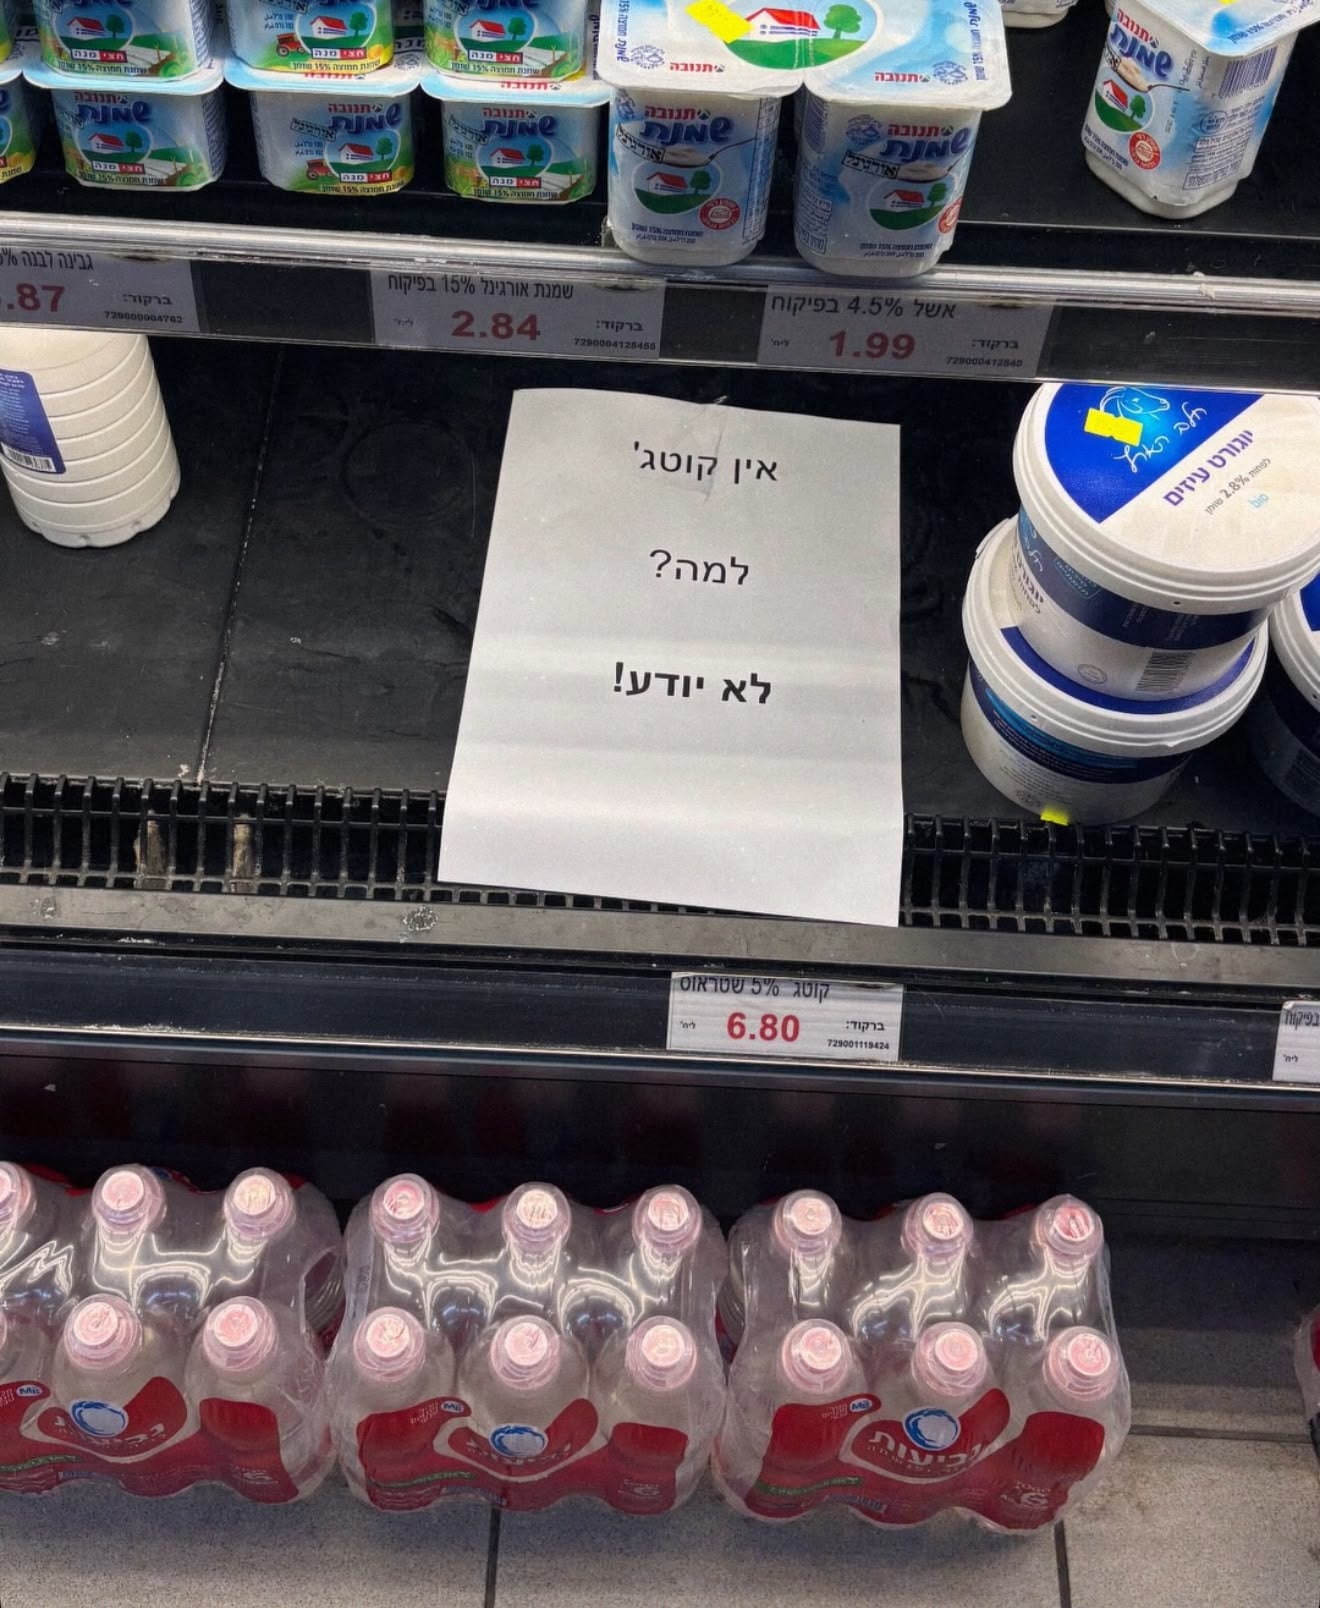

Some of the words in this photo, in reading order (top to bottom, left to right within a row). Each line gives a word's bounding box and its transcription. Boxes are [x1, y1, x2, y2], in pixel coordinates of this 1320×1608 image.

[1116, 8, 1150, 43] תנובה
[1109, 23, 1173, 81] שמנת
[670, 62, 713, 73] תנובה
[875, 71, 919, 83] תנובה
[77, 101, 151, 124] שמנת
[328, 102, 371, 114] תנובה
[328, 102, 402, 134] שמנת
[482, 107, 525, 119] תנובה
[644, 105, 696, 120] תנובה
[480, 115, 557, 138] שמנת
[639, 117, 733, 146] שמנת
[888, 124, 940, 137] תנובה
[879, 127, 971, 163] שמנת
[22, 250, 53, 270] לבנה
[58, 252, 94, 271] גבינה
[387, 274, 437, 296] בפיקוח
[441, 274, 476, 295] 15%
[480, 276, 529, 298] אורגינל
[534, 282, 575, 300] שמנת
[0, 282, 66, 313] .87
[122, 293, 174, 306] ברקוד:
[771, 295, 840, 317] בפיקוח
[847, 296, 904, 317] 4.5%
[914, 298, 957, 319] אשל
[451, 310, 541, 341] 2.84
[595, 319, 644, 333] ברקוד:
[829, 329, 915, 360] 1.99
[971, 339, 1019, 351] ברקוד:
[1206, 429, 1254, 470] יוגורט
[633, 440, 719, 482] קוטג'
[733, 457, 779, 485] אין
[1162, 466, 1211, 507] עיזים
[1219, 474, 1250, 499] 2.8%
[649, 548, 750, 586] למה?
[613, 661, 705, 698] יודע!
[720, 672, 772, 705] לא
[680, 976, 745, 995] שטראוס
[751, 977, 780, 997] 5%
[792, 982, 831, 1005] קוטג
[680, 1020, 697, 1030] ליח'
[726, 1011, 801, 1042] 6.80
[845, 1020, 886, 1033] ברקוד:
[868, 1430, 983, 1467] נביעות
